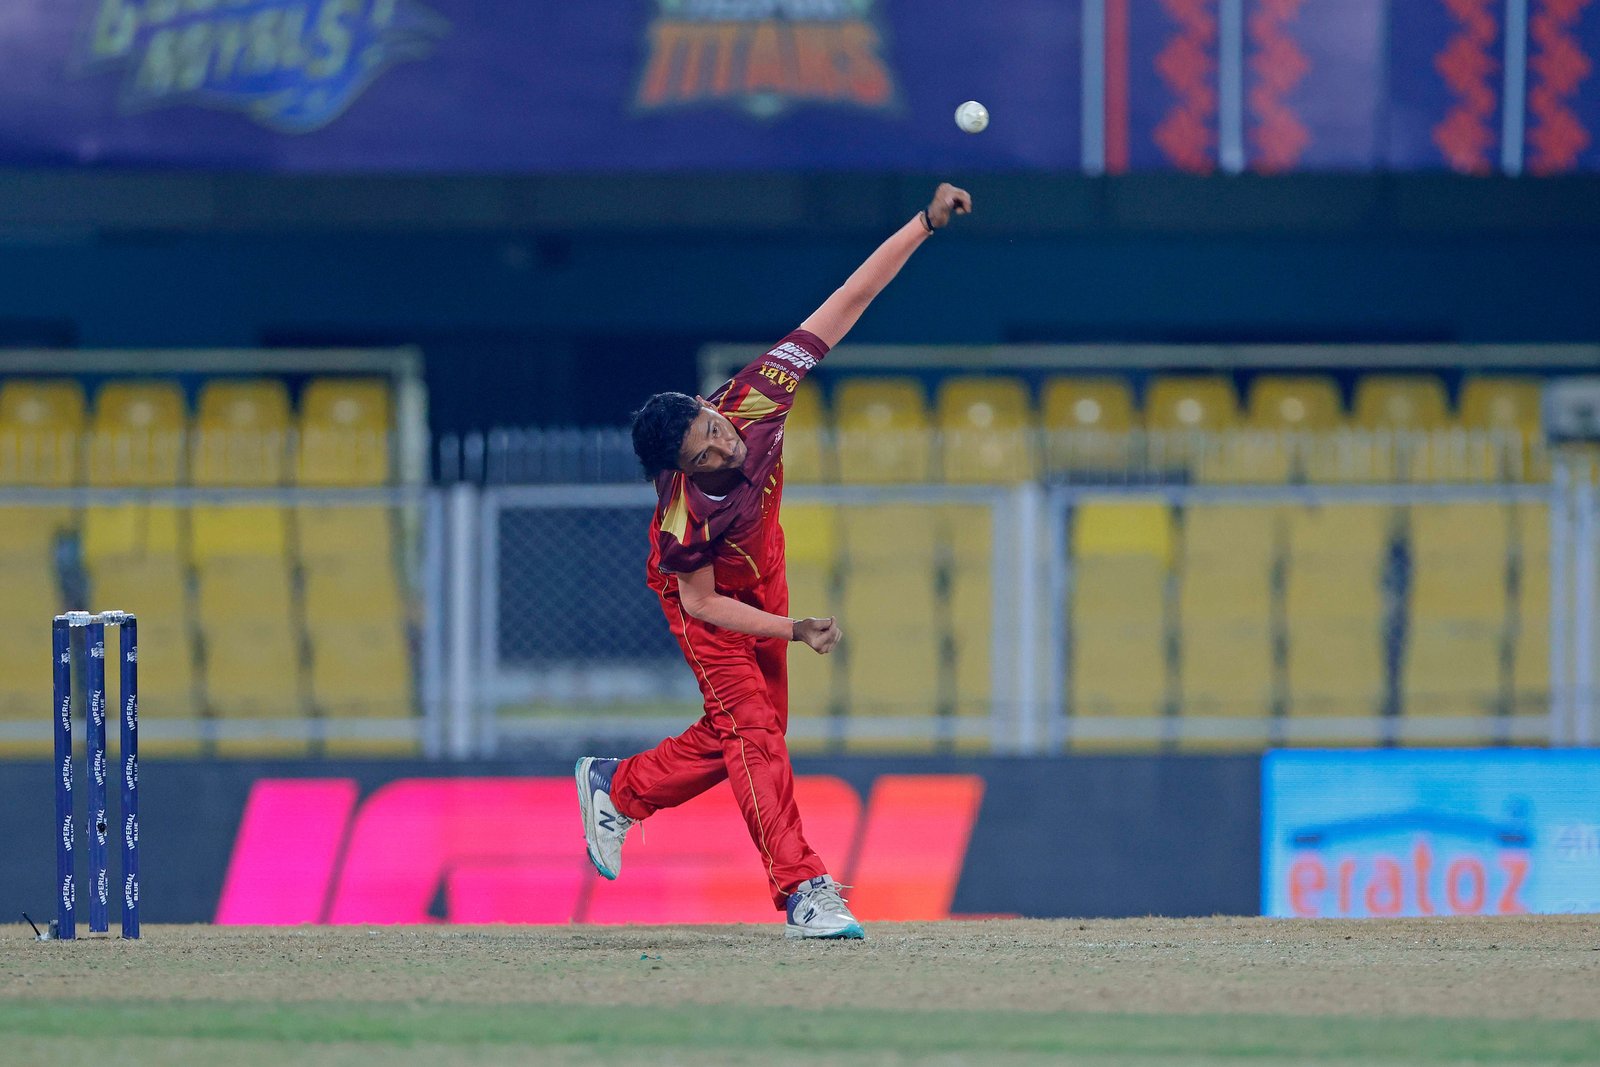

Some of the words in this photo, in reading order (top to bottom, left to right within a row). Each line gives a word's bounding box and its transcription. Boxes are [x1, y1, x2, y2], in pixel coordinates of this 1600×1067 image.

[758, 363, 798, 393] BABY
[61, 695, 71, 732] IMPERIAL
[91, 690, 103, 727] IMPERIAL
[126, 694, 137, 731] IMPERIAL
[62, 755, 72, 792] IMPERIAL
[94, 749, 104, 786] IMPERIAL
[125, 754, 136, 791] IMPERIAL
[62, 815, 73, 852] IMPERIAL
[95, 809, 106, 846] IMPRIAL
[125, 813, 136, 850] IMPERIAL
[62, 874, 73, 911] IMPERIAL
[97, 868, 107, 906] IMPERIAL
[125, 873, 136, 910] IMPERIAL
[1288, 836, 1531, 914] eratoz
